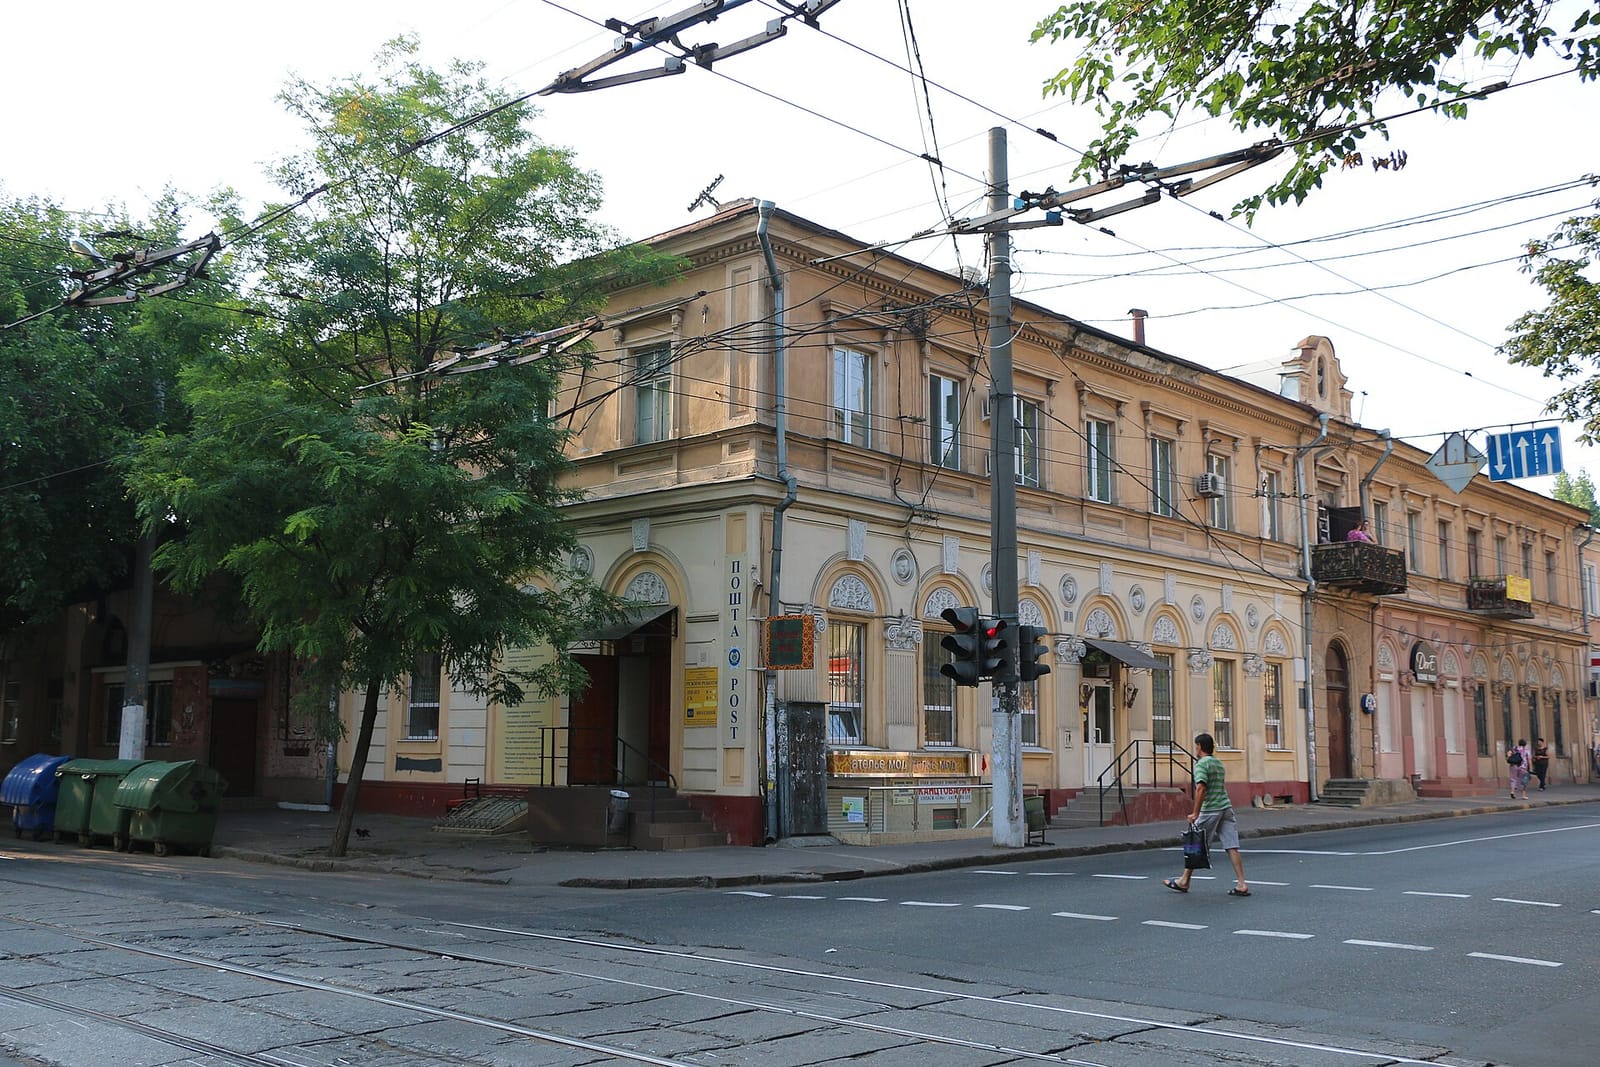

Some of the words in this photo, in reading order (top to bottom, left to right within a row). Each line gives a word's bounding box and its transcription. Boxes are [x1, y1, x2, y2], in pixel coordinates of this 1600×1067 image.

[729, 560, 741, 637] ПОШТА
[729, 678, 739, 740] POST
[851, 759, 885, 770] ателье
[888, 759, 907, 770] мод
